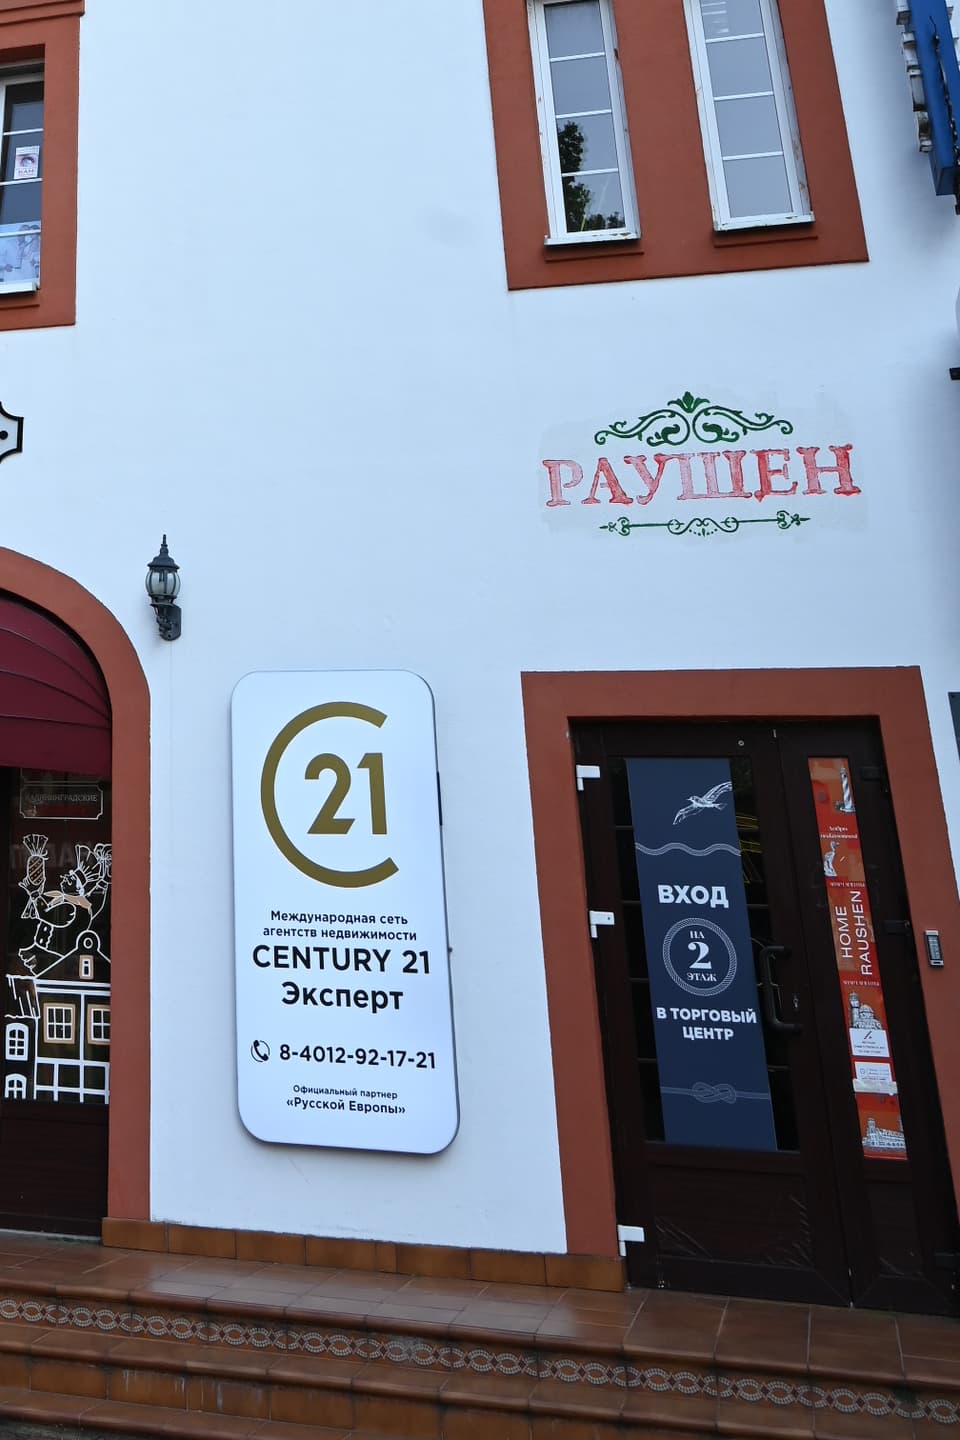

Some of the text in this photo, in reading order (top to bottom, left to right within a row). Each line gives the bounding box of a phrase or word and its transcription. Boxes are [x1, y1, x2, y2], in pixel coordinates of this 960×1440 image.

[542, 444, 862, 507] РАУШЕН
[657, 884, 730, 909] ВХОД
[270, 910, 409, 925] Международная сеть
[263, 926, 417, 941] агентств недвижимости
[689, 930, 705, 939] НА
[835, 905, 853, 958] HOME
[849, 890, 873, 975] RAUSHEN
[252, 944, 430, 974] CENTURY 21
[687, 941, 712, 970] 2
[686, 972, 717, 982] ЭТАЖ
[281, 981, 404, 1014] Эксперт
[656, 1007, 758, 1024] В ТОРГОВЫЙ
[682, 1026, 734, 1041] ЦЕНТР
[279, 1043, 436, 1069] 8-4012-92-17-21
[292, 1084, 398, 1100] Официальный партнер
